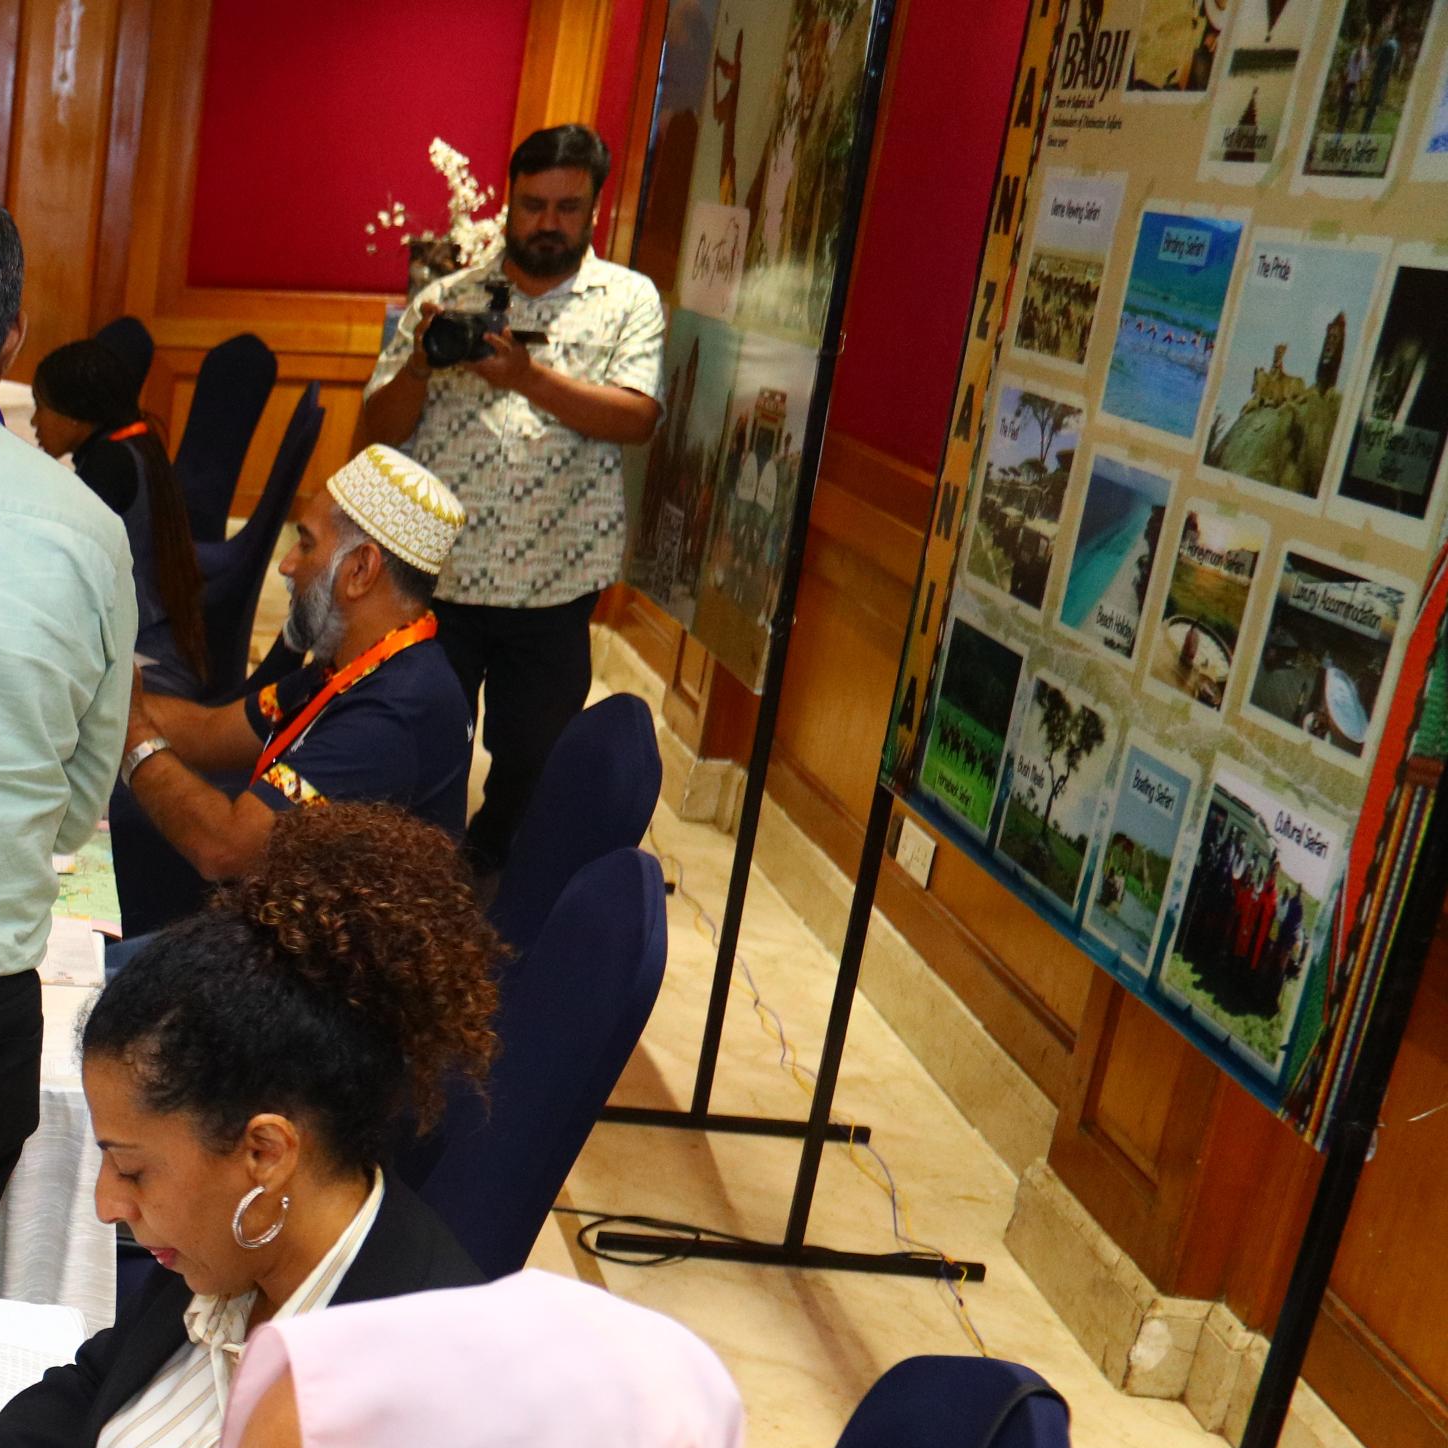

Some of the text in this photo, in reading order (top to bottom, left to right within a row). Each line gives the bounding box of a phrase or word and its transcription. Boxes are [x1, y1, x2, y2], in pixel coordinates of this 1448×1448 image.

[1257, 255, 1292, 282] The Pride
[1096, 604, 1114, 632] Beach
[1319, 586, 1381, 628] Accommodation
[1015, 753, 1031, 778] Bush
[1154, 782, 1176, 813] Safari
[1274, 809, 1330, 860] Cultural Safari
